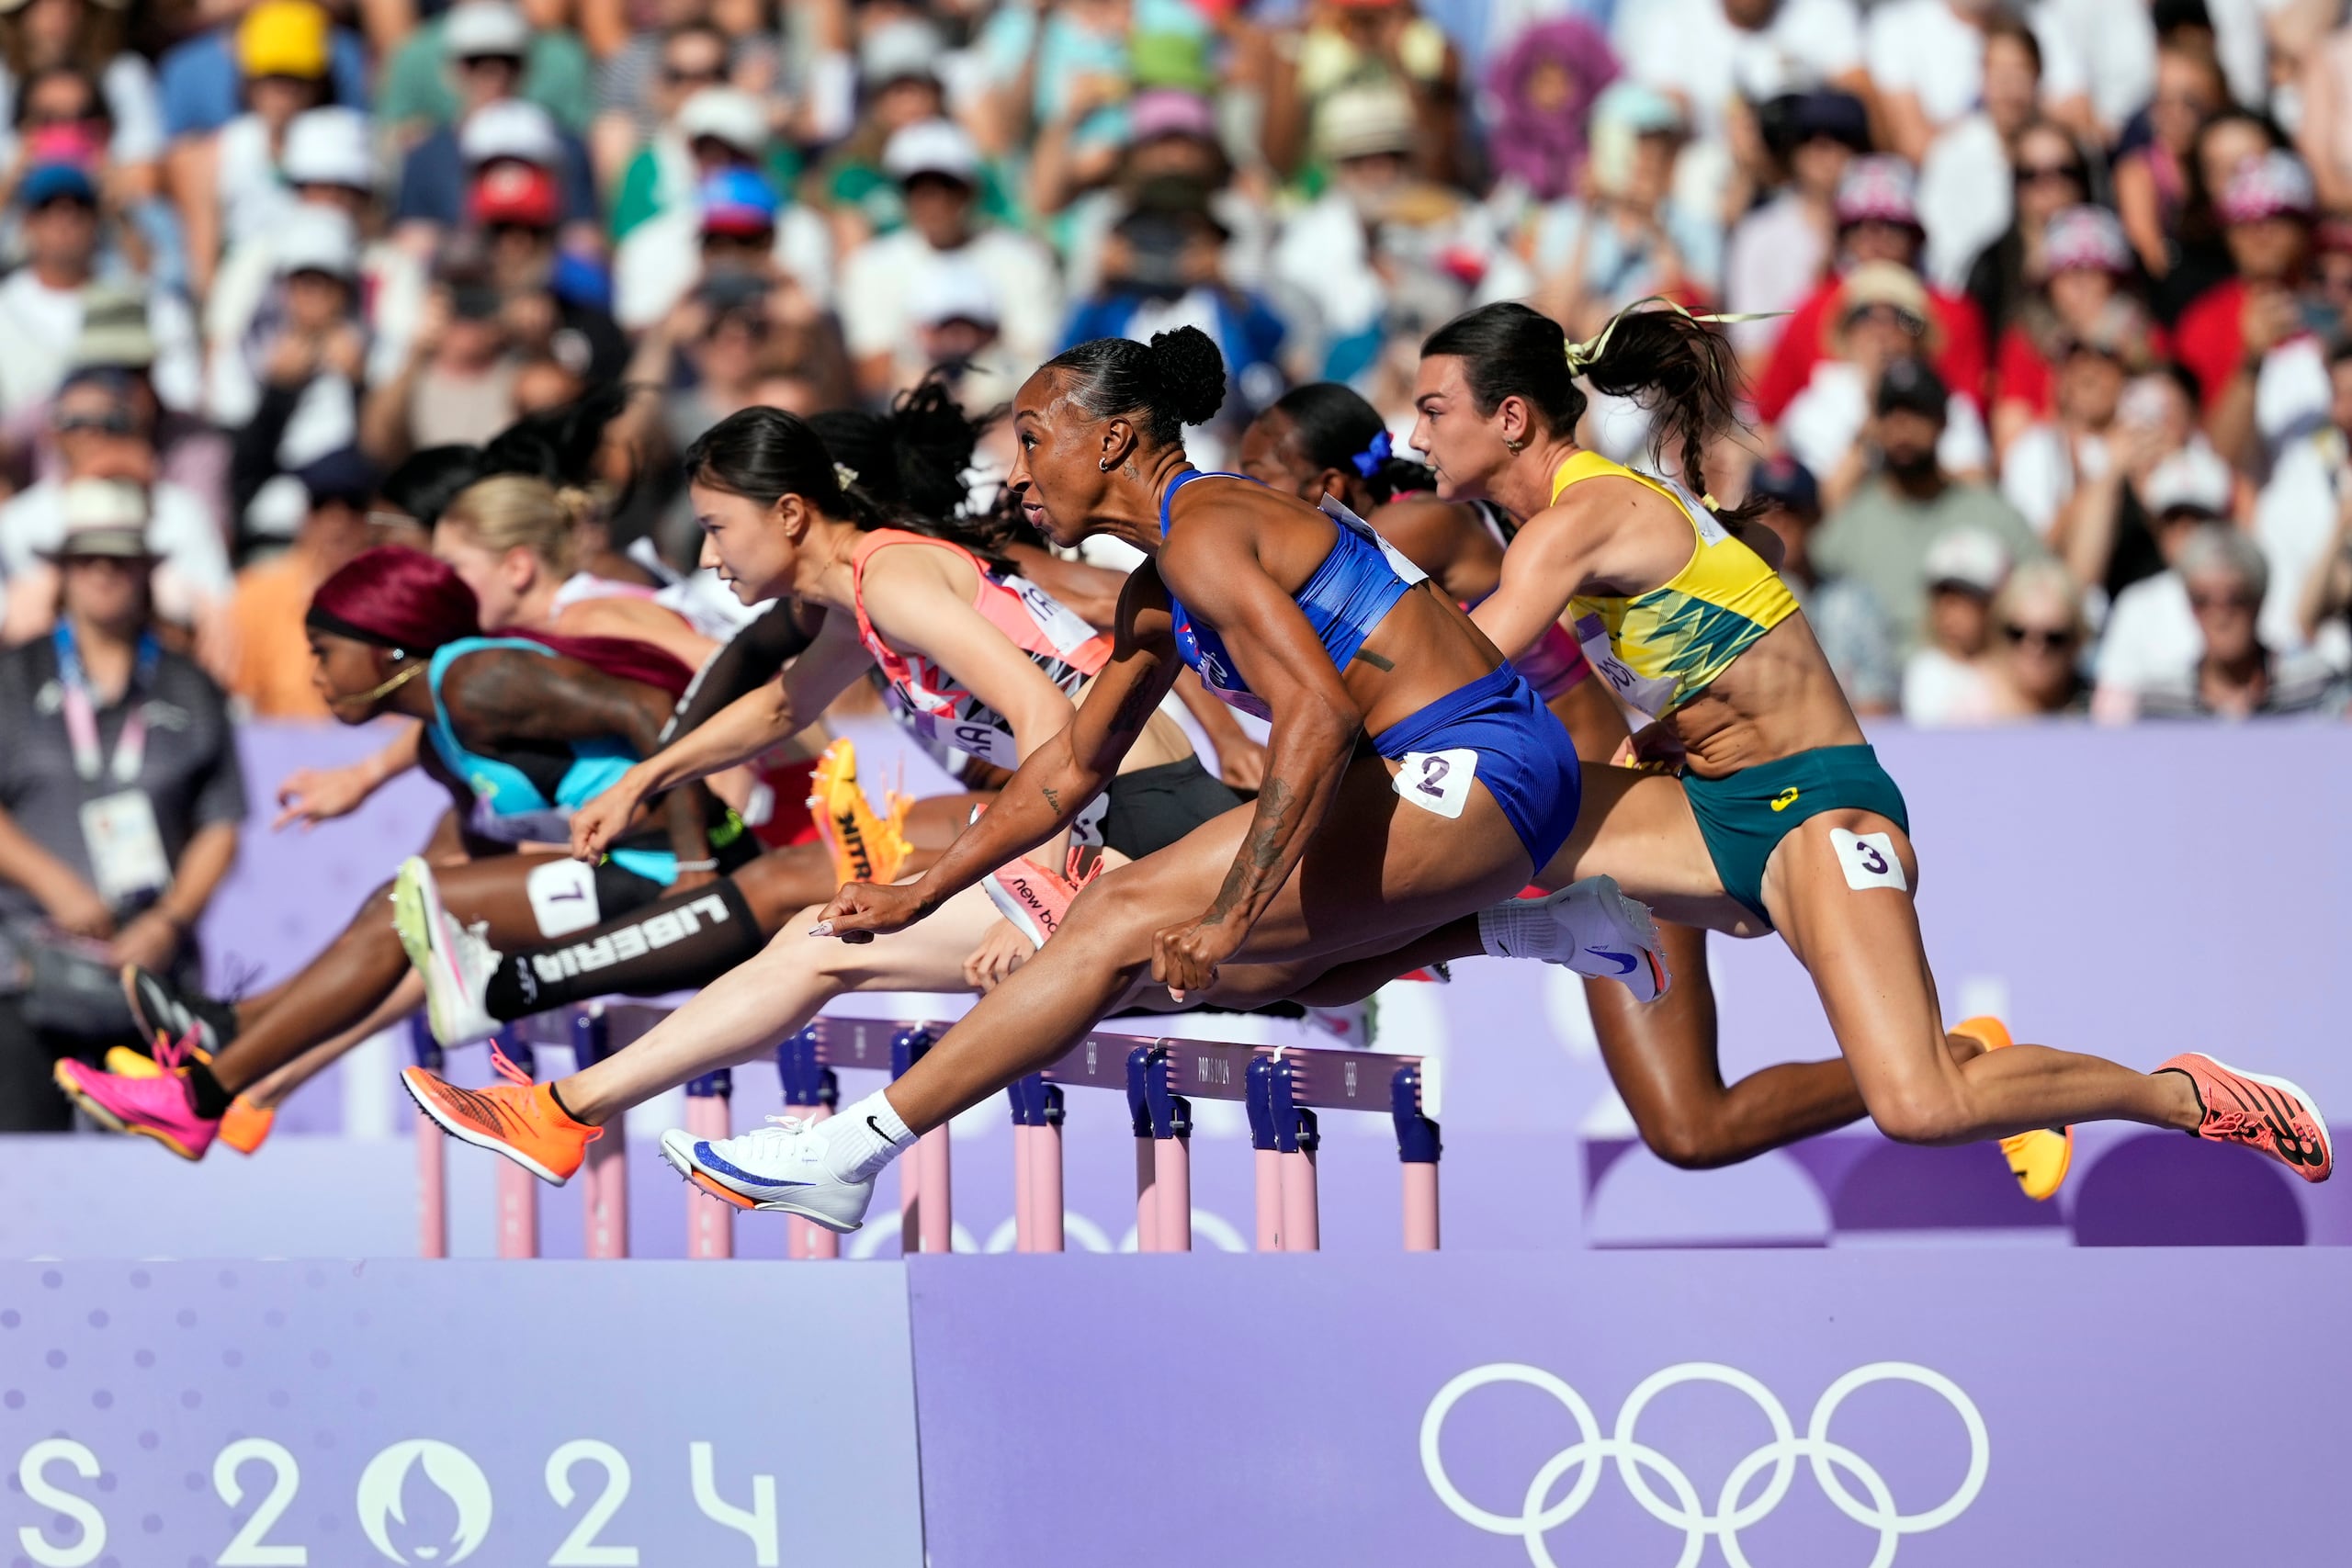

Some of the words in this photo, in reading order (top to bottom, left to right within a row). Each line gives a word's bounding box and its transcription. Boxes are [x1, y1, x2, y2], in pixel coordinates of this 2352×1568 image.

[1416, 755, 1451, 799] 2
[837, 811, 872, 881] NITR
[1856, 840, 1889, 875] 3
[1012, 878, 1044, 908] new
[531, 893, 730, 984] LIBERIA
[1198, 1056, 1214, 1082] PARIS
